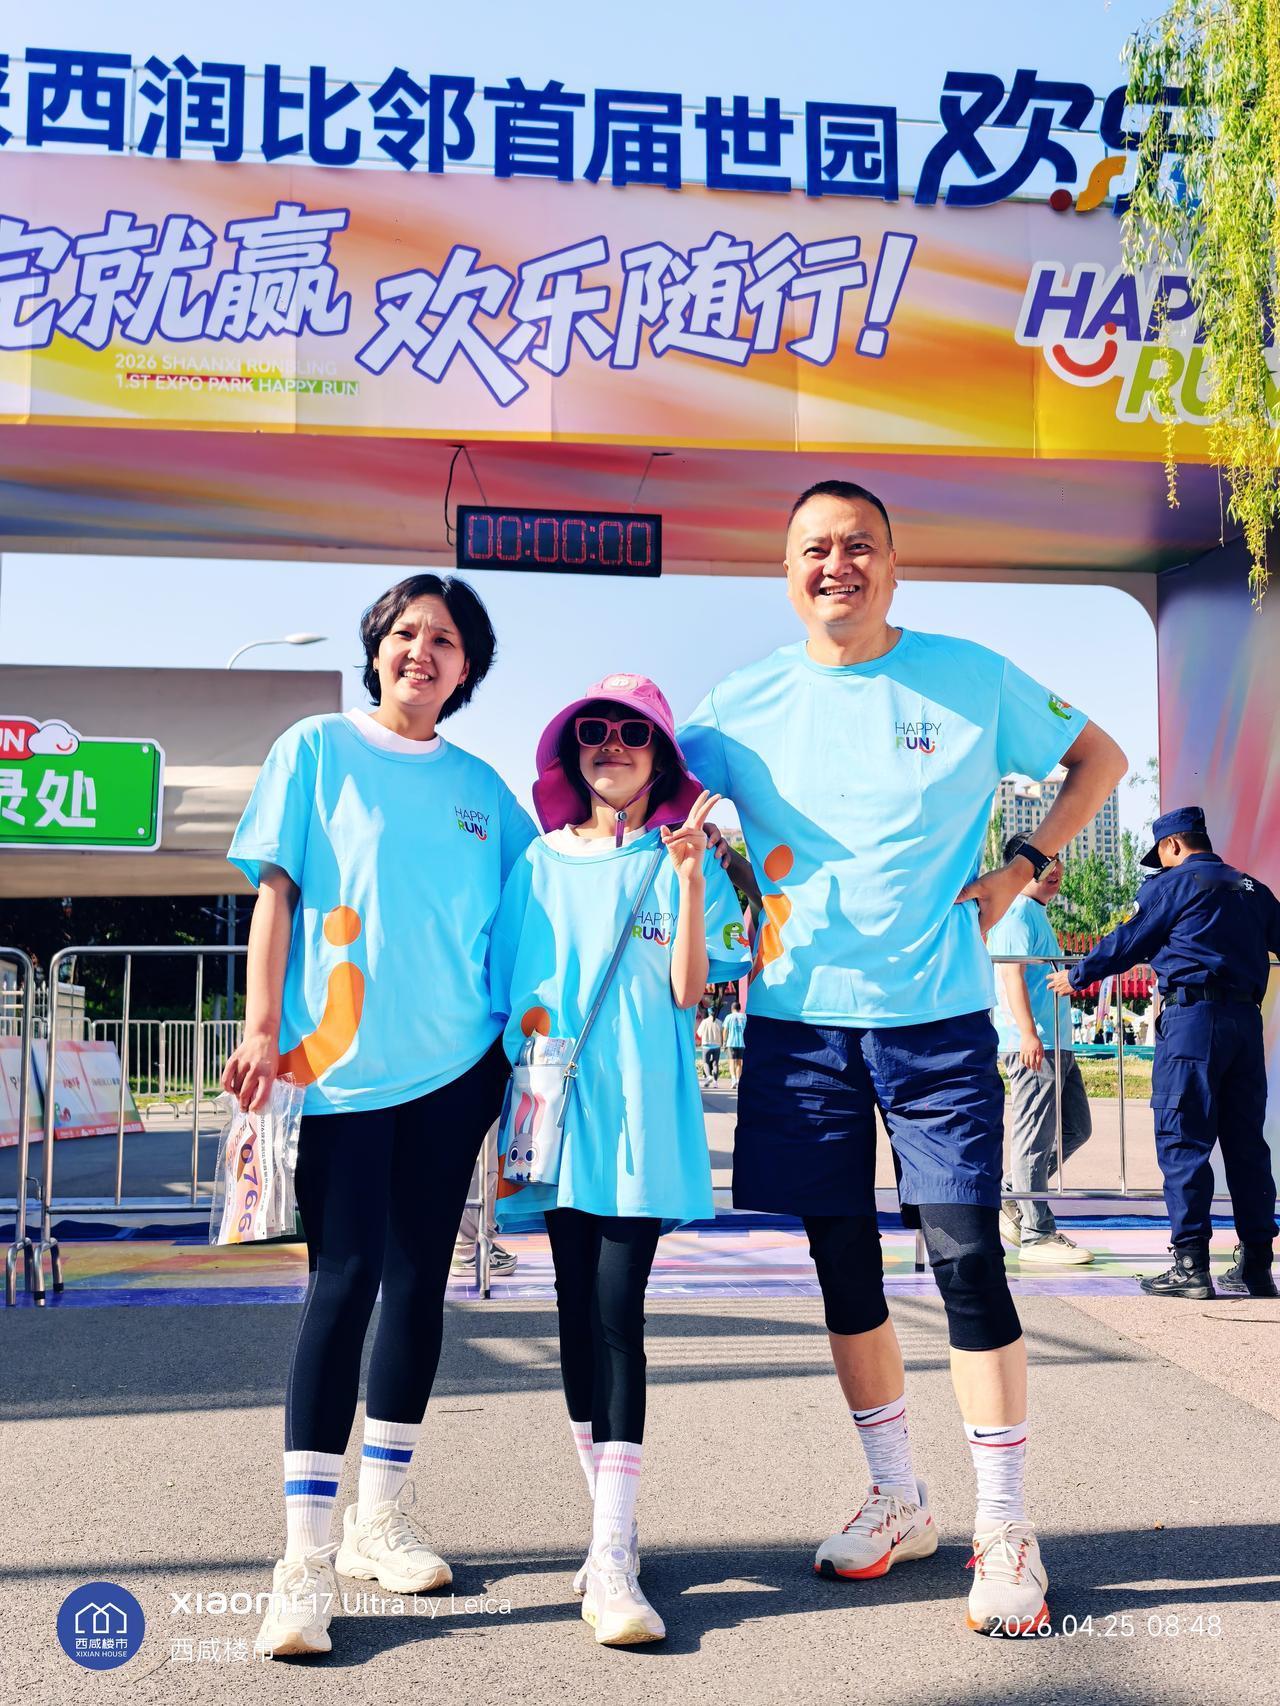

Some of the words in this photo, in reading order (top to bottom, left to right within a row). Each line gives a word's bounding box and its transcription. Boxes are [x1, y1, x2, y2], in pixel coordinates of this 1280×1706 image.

[115, 353, 157, 370] 2026
[163, 356, 240, 374] SHAANXI
[115, 374, 150, 389] 1.ST
[156, 375, 203, 391] EXPO
[208, 377, 254, 392] PARK
[258, 378, 317, 394] HAPPY
[322, 380, 359, 396] RUN
[467, 514, 651, 567] 00:00:00
[894, 721, 942, 736] HAPPY
[895, 736, 930, 751] RUN
[454, 805, 490, 826] HAPPY
[457, 818, 484, 838] RUN
[636, 910, 679, 926] HAPPY
[631, 925, 666, 941] RUN
[238, 1143, 258, 1234] 0766
